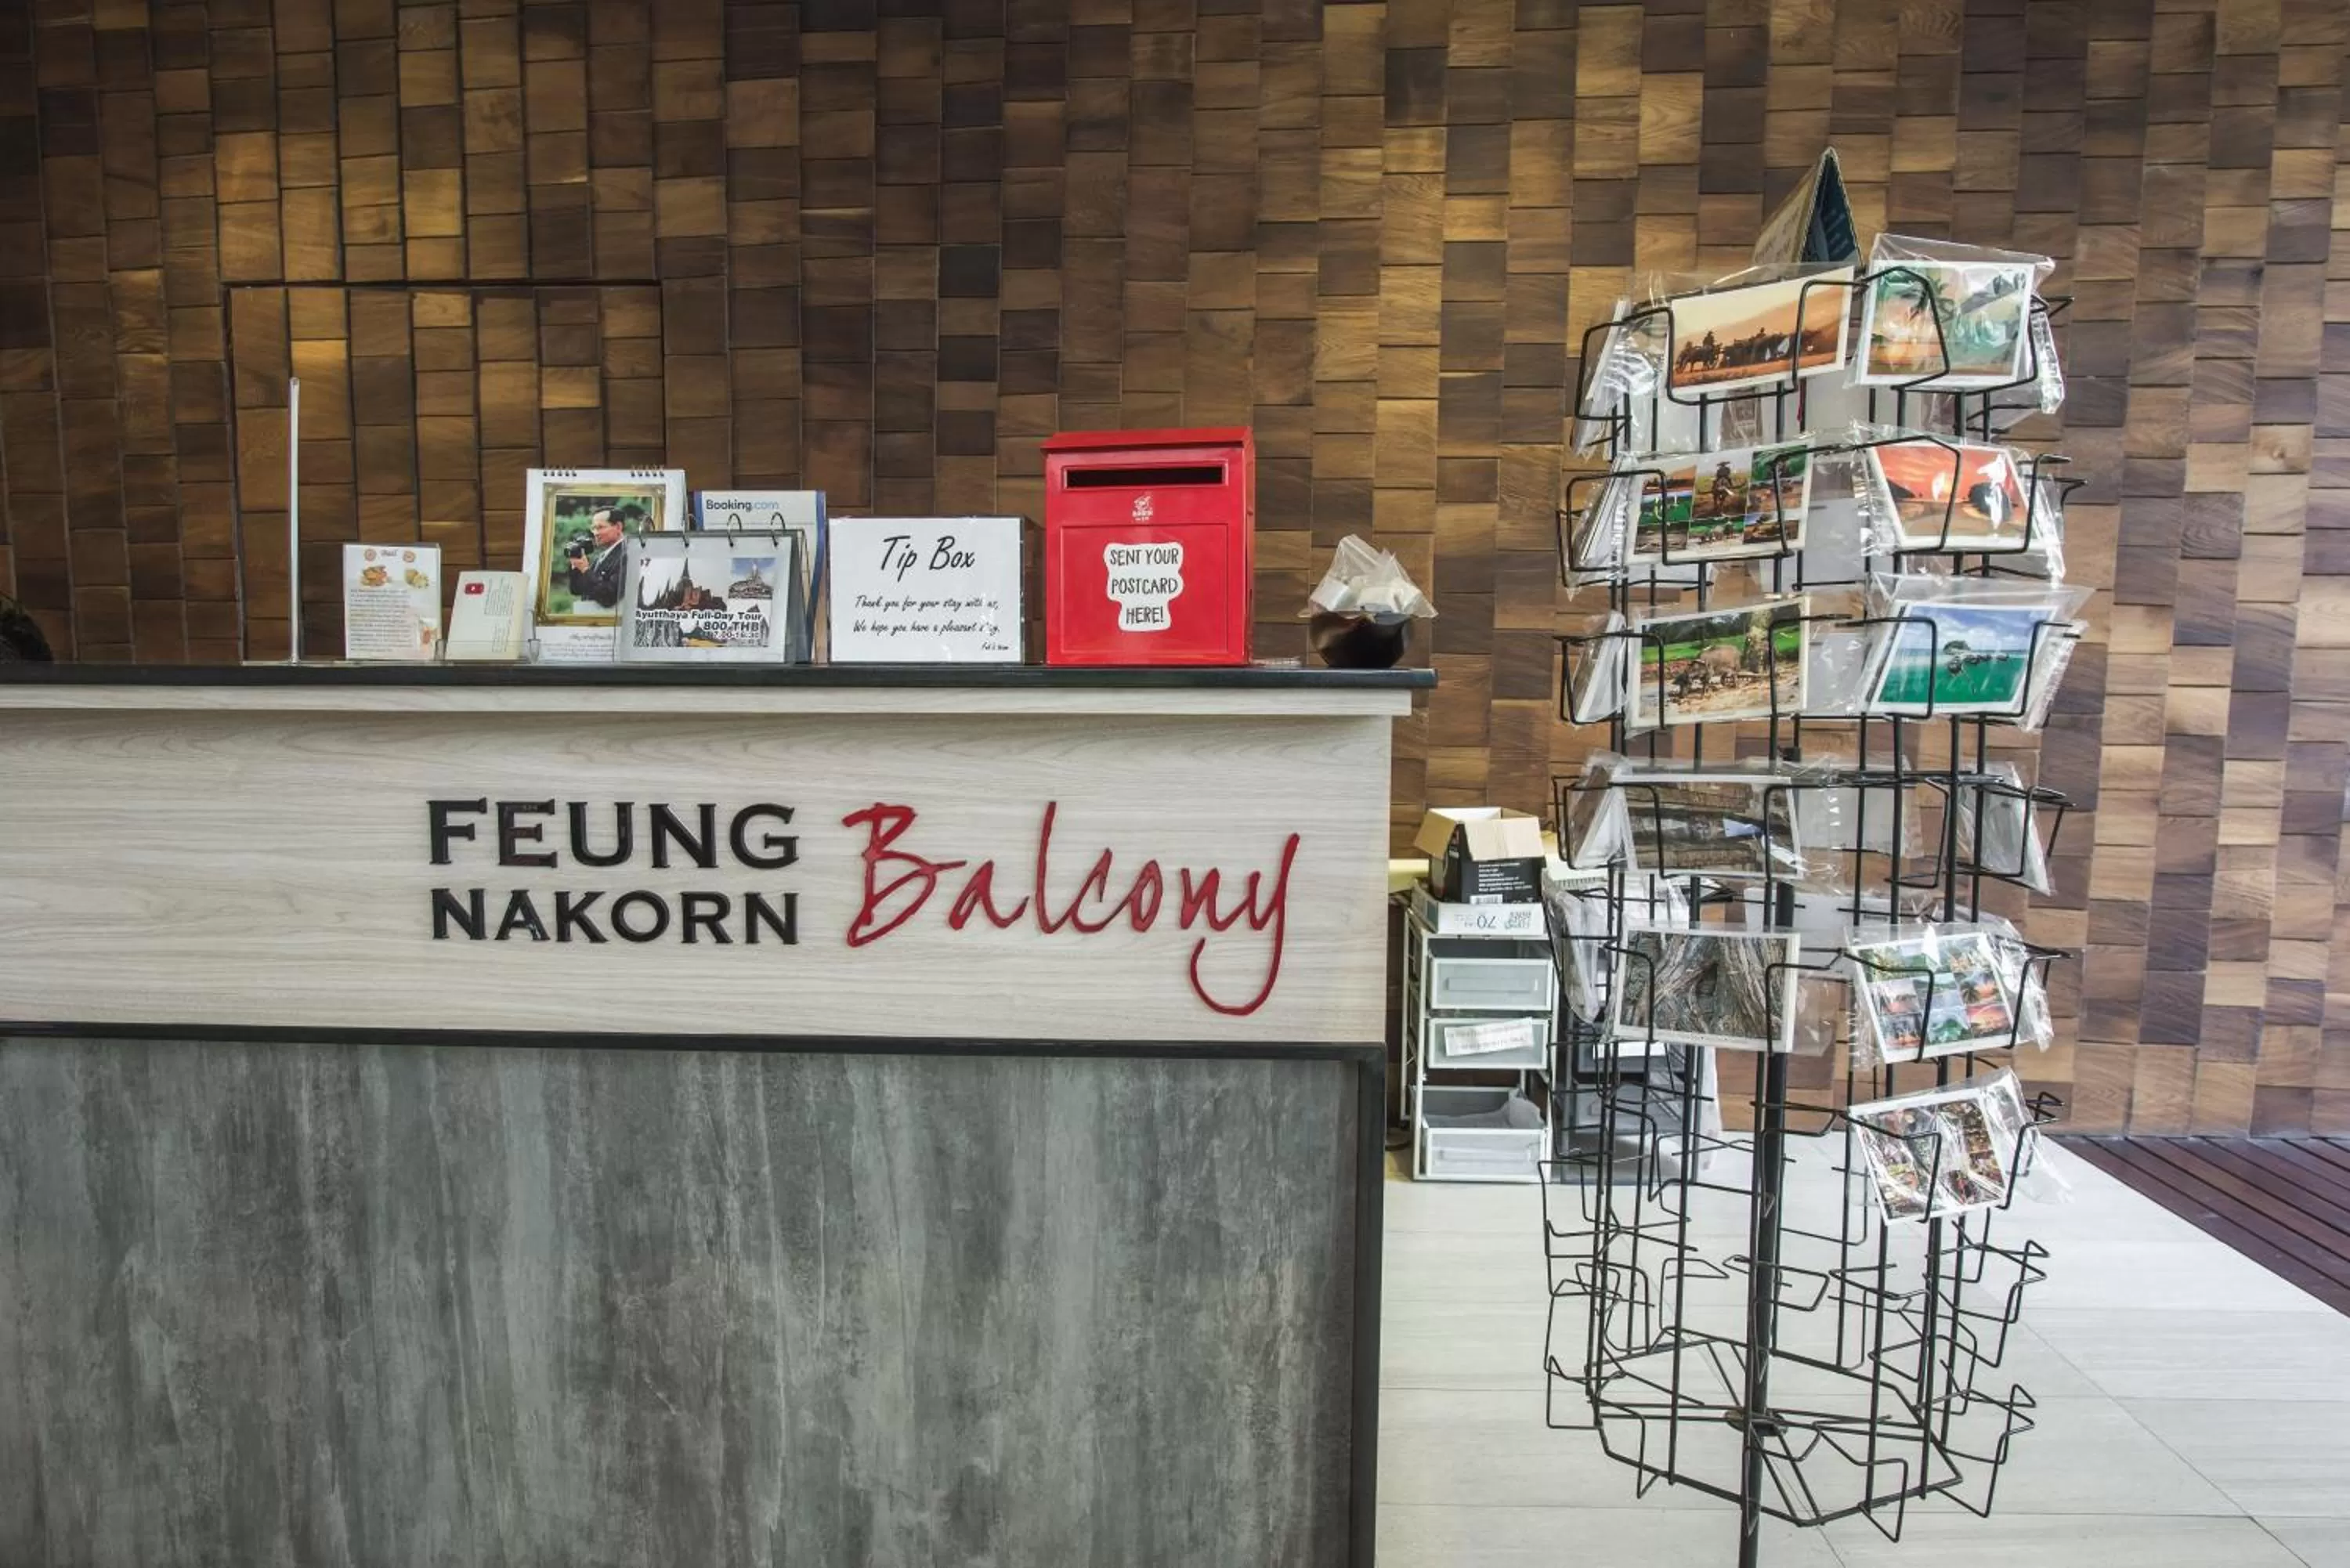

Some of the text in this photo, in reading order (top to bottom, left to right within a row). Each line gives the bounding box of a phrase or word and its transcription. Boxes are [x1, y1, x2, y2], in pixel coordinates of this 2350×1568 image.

[880, 535, 976, 583] Tip Box
[1109, 547, 1179, 566] SENT YOUR
[1111, 577, 1179, 594] POSTCARD
[855, 594, 884, 609] Thank
[884, 601, 900, 612] you
[902, 595, 917, 612] for
[917, 601, 940, 612] your
[942, 598, 963, 612] stay
[738, 612, 762, 620] Tour
[1125, 605, 1164, 624] HERE!
[870, 620, 889, 637] hope
[890, 626, 907, 637] you
[909, 620, 929, 633] have
[938, 620, 978, 637] pleasant
[427, 797, 1301, 1017] FEUNG Balcony
[430, 888, 800, 945] NAKORN
